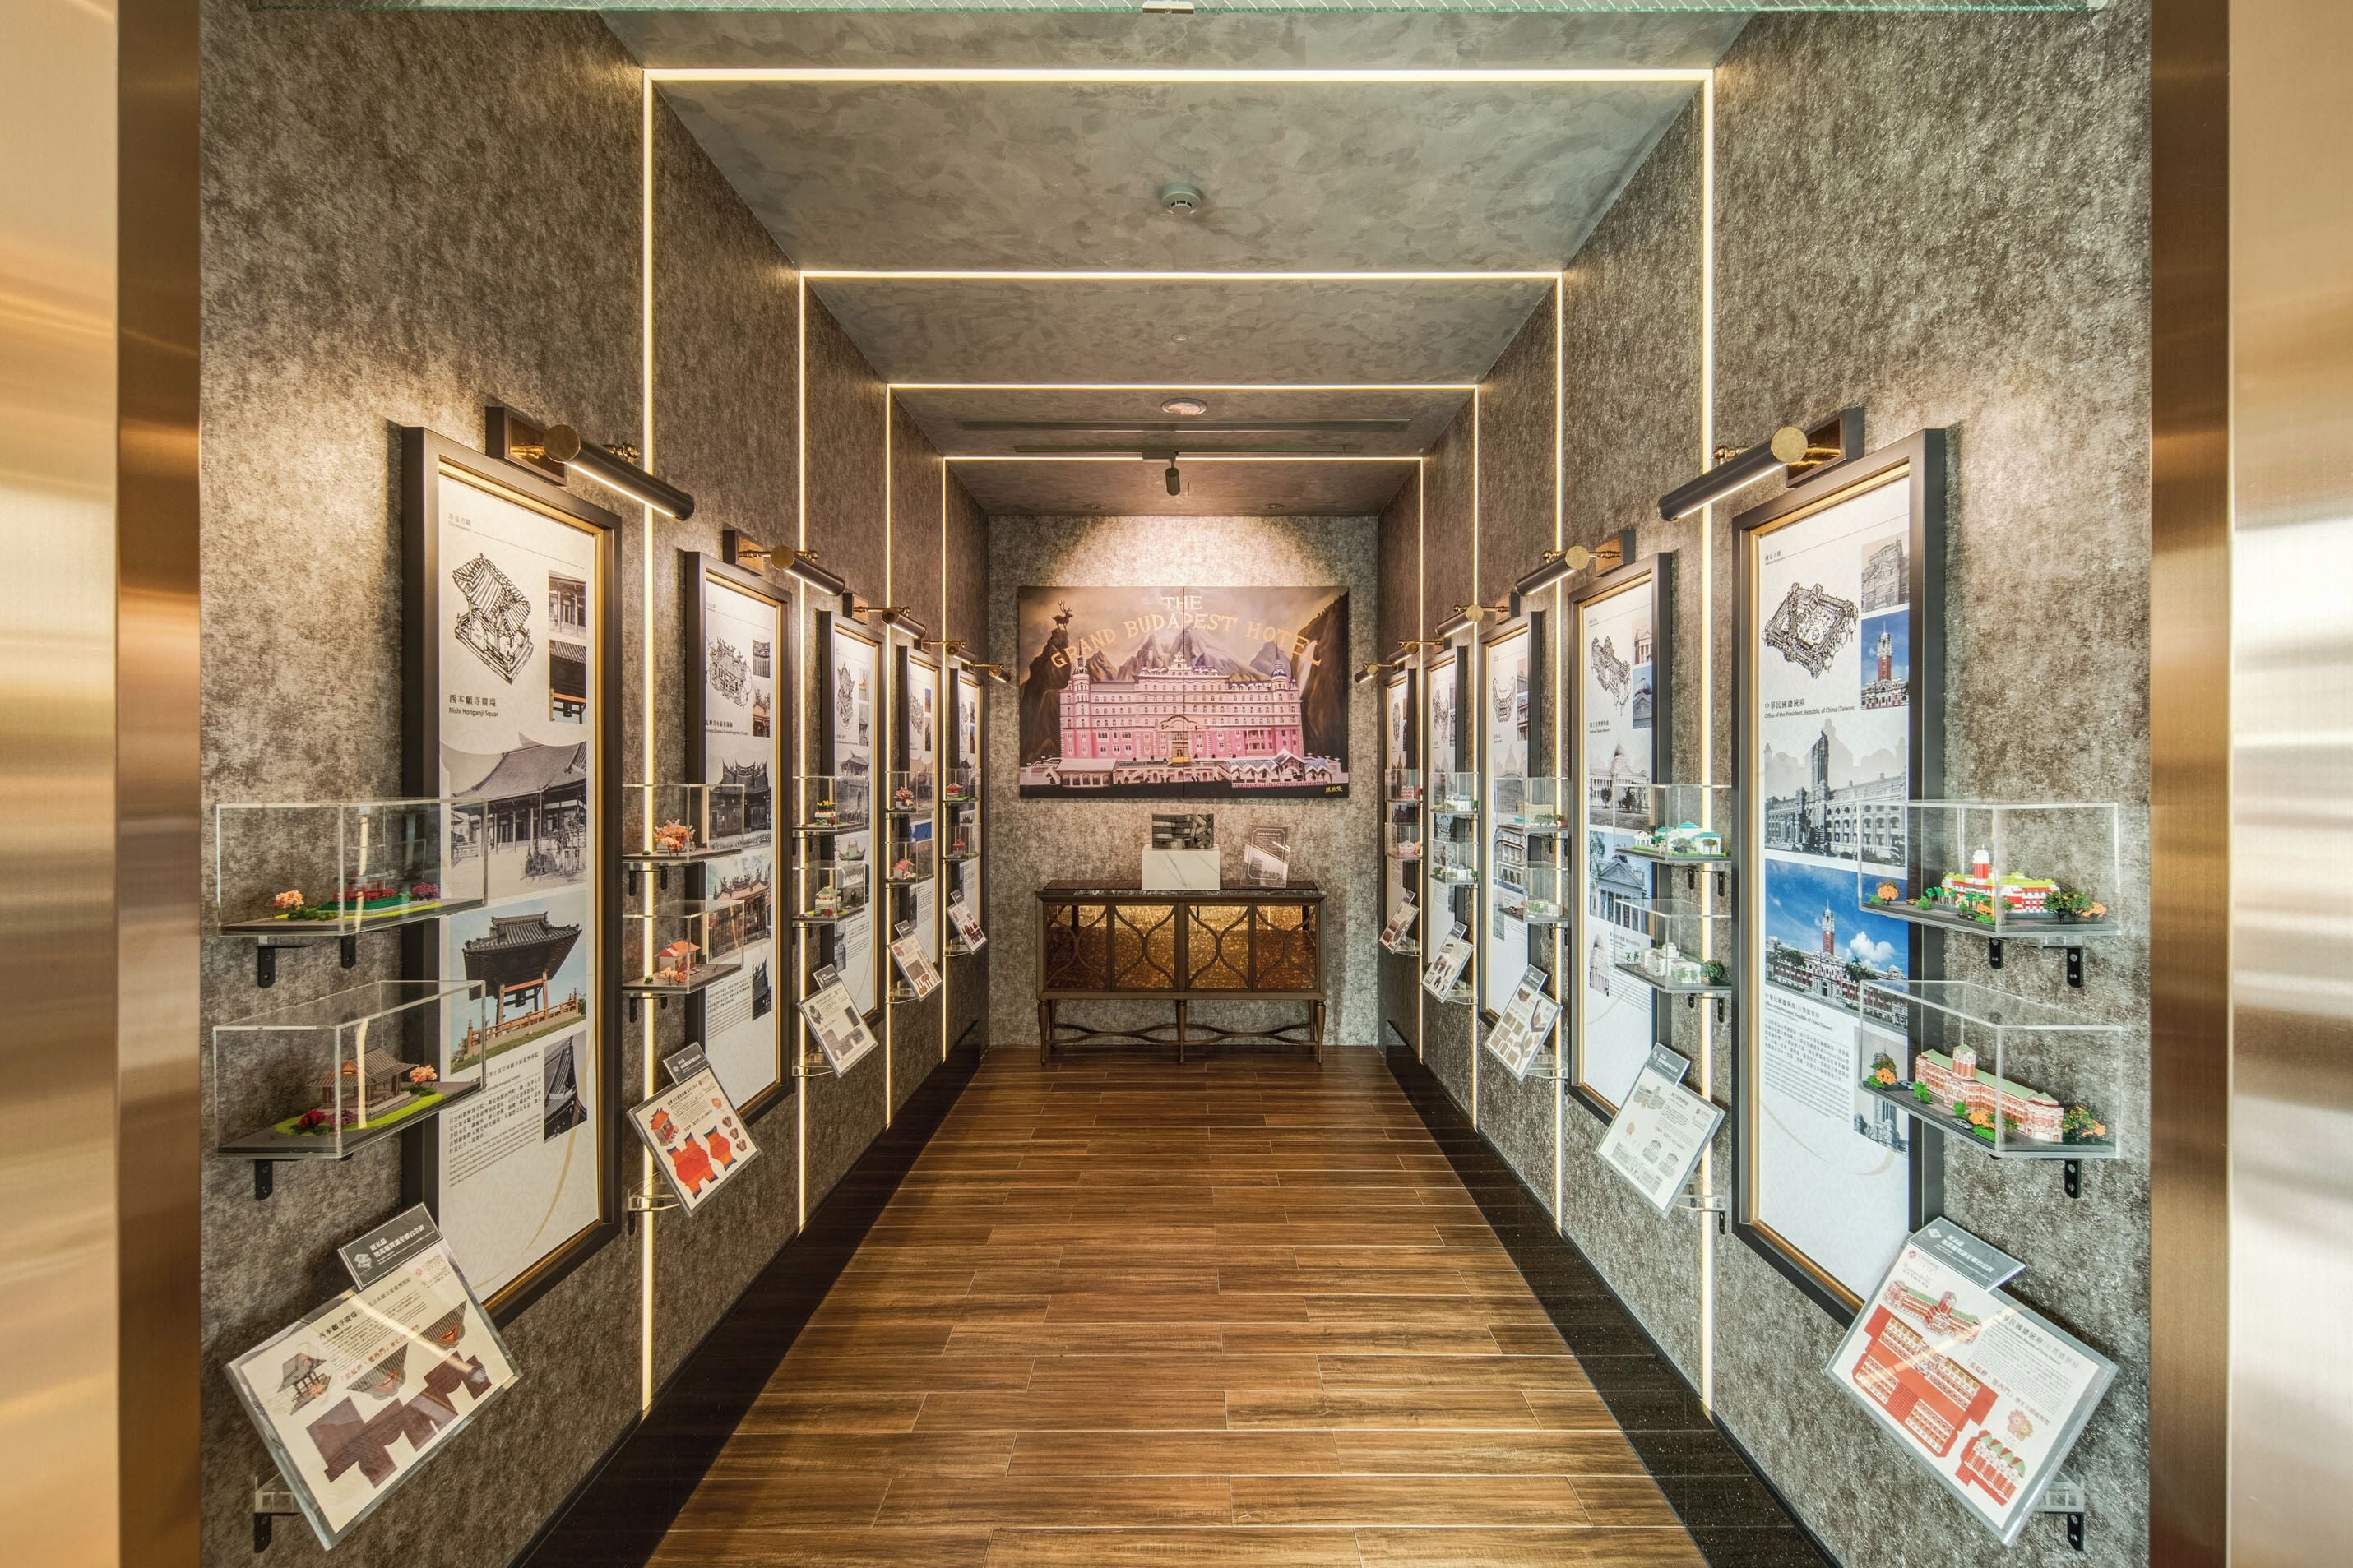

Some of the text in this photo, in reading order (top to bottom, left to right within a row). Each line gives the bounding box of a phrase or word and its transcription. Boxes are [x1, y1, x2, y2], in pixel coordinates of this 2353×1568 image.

[1160, 596, 1202, 611] THE
[1050, 613, 1322, 668] GRAND BUDAPEST HOTEL
